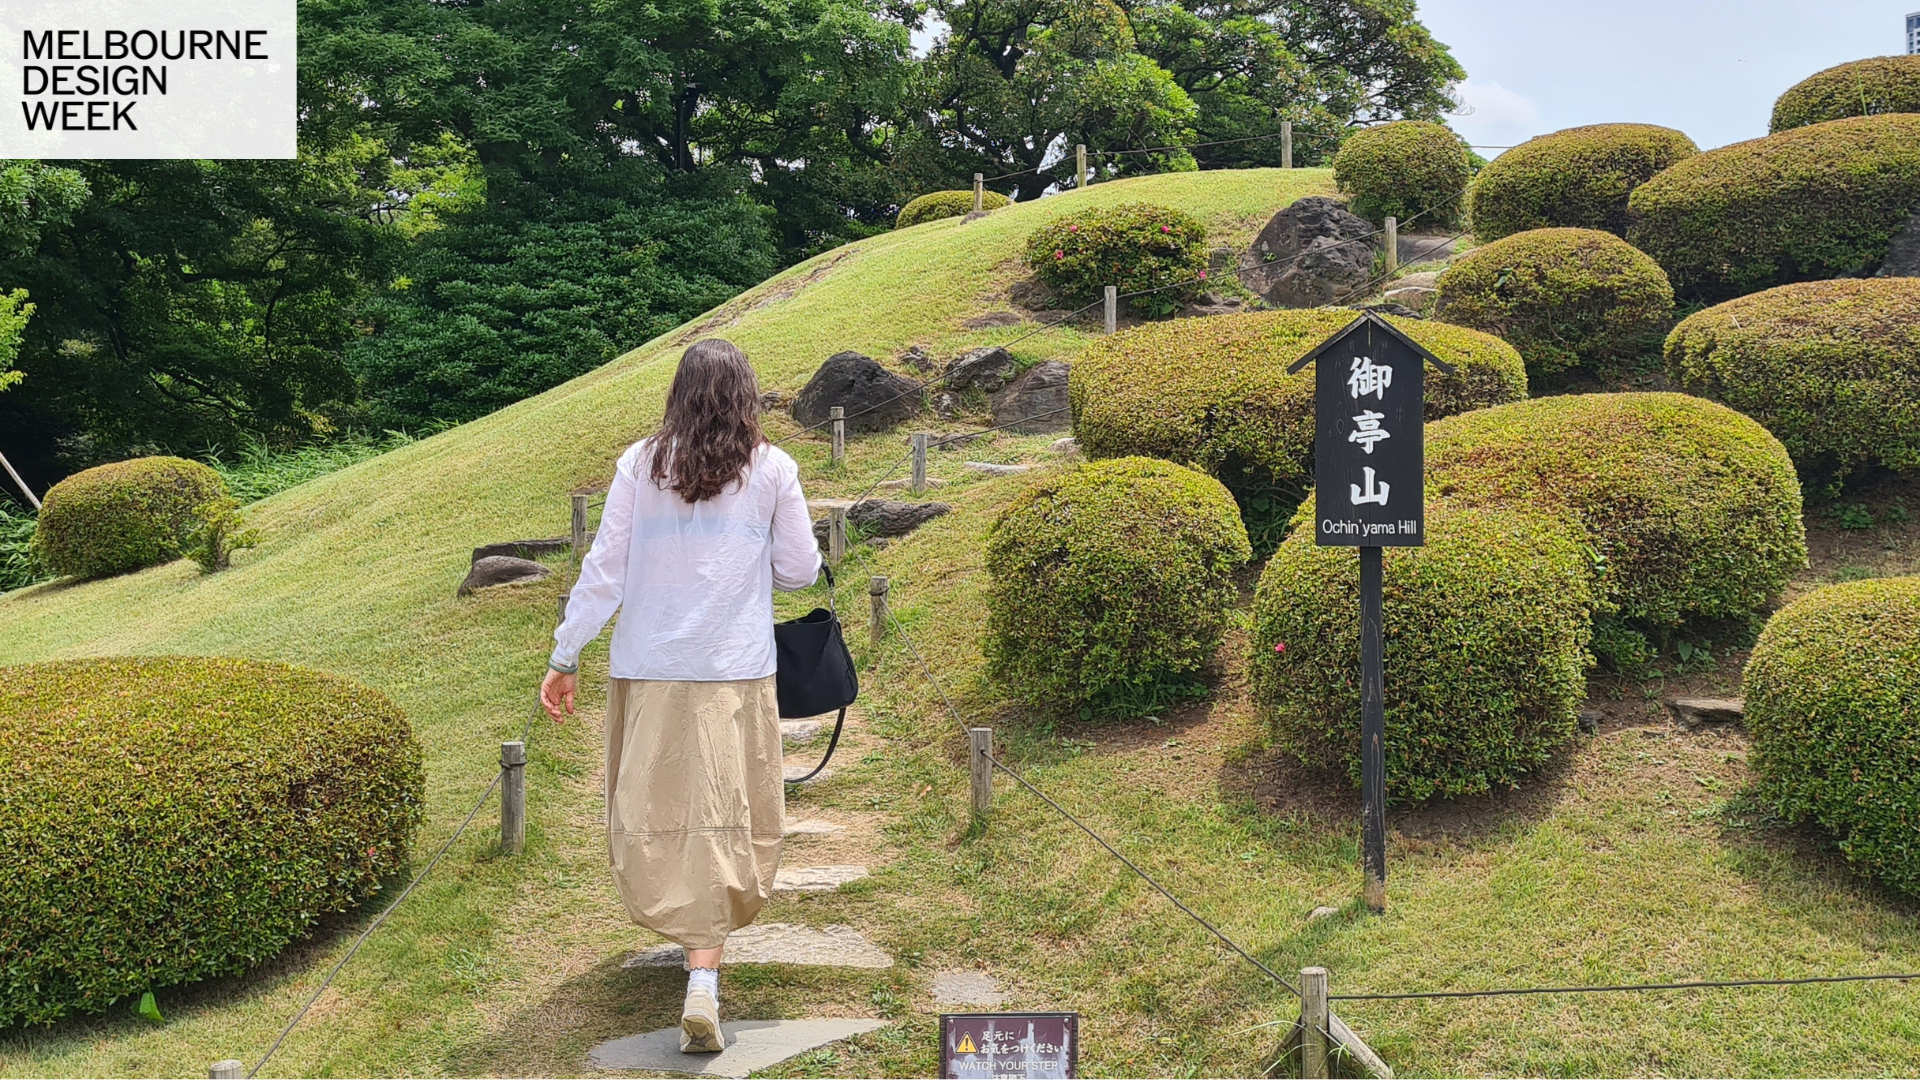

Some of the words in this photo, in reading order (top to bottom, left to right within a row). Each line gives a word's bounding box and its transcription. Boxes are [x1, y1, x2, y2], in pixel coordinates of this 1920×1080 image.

[1347, 356, 1393, 506] 御亭山
[1322, 519, 1395, 537] Ochin'yama
[1398, 519, 1417, 534] Hill
[981, 1031, 1015, 1041] 足元に
[980, 1043, 1063, 1054] お気をつけください
[959, 1061, 997, 1071] WATCH
[1000, 1061, 1028, 1071] YOUR
[1032, 1061, 1058, 1071] STEP
